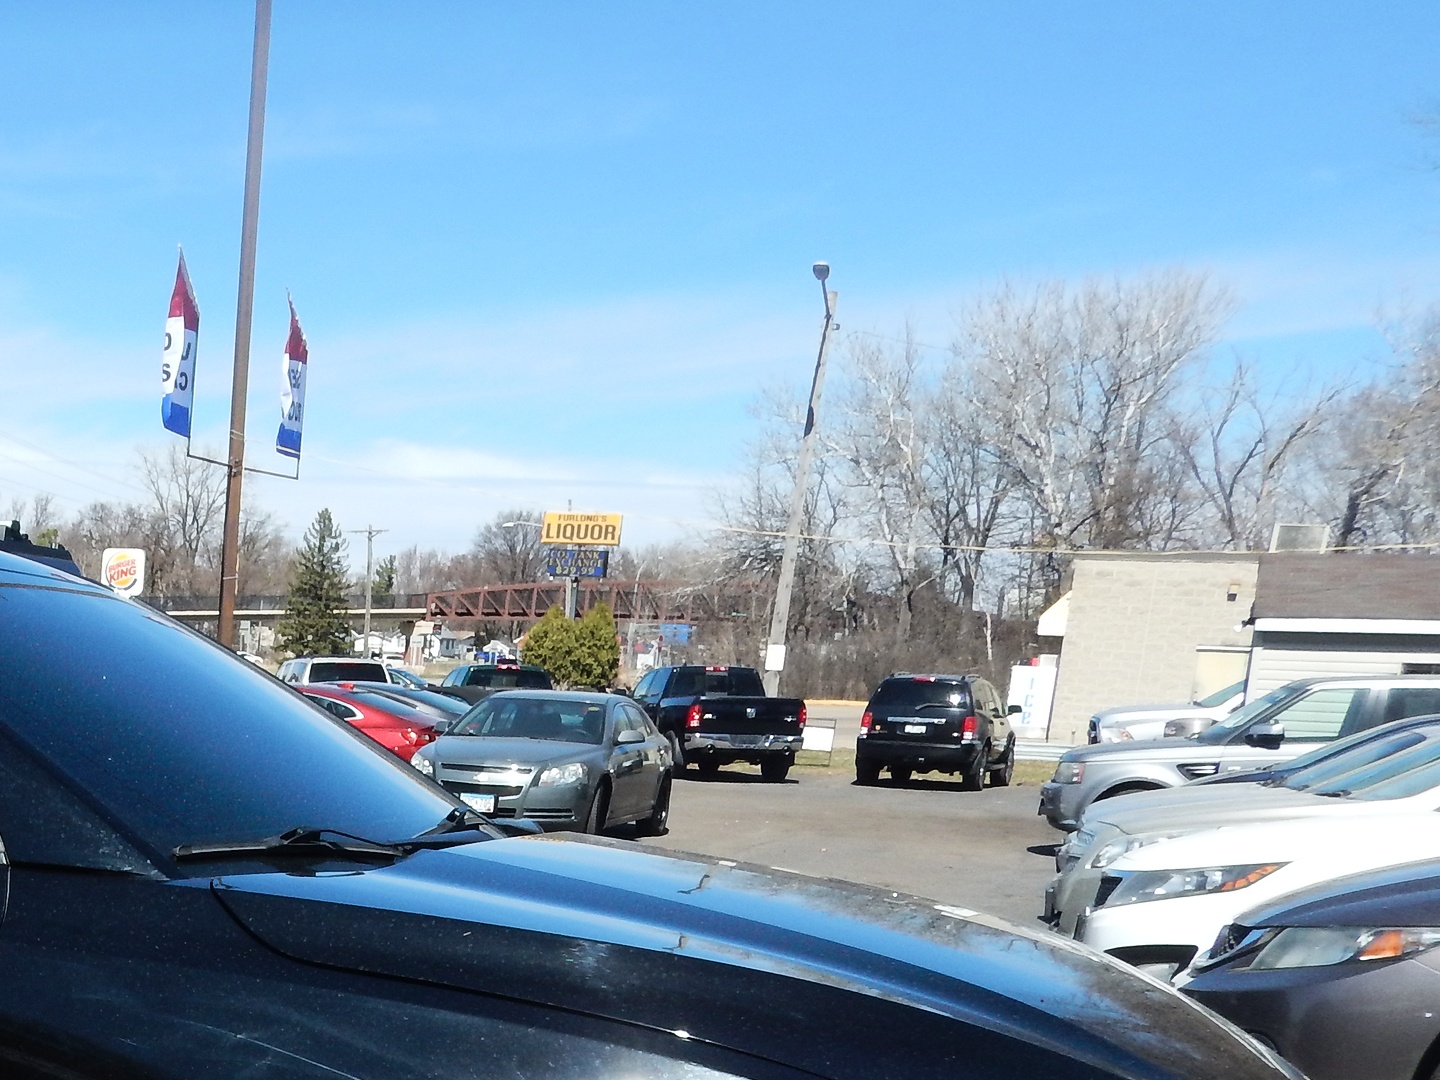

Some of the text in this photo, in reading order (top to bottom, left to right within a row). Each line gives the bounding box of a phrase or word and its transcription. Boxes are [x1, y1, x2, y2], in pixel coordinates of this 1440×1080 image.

[545, 523, 616, 541] LIQUOR
[573, 550, 600, 559] TANK
[109, 559, 136, 573] BURGER
[548, 558, 603, 567] EXCHANGE
[109, 566, 136, 583] KING
